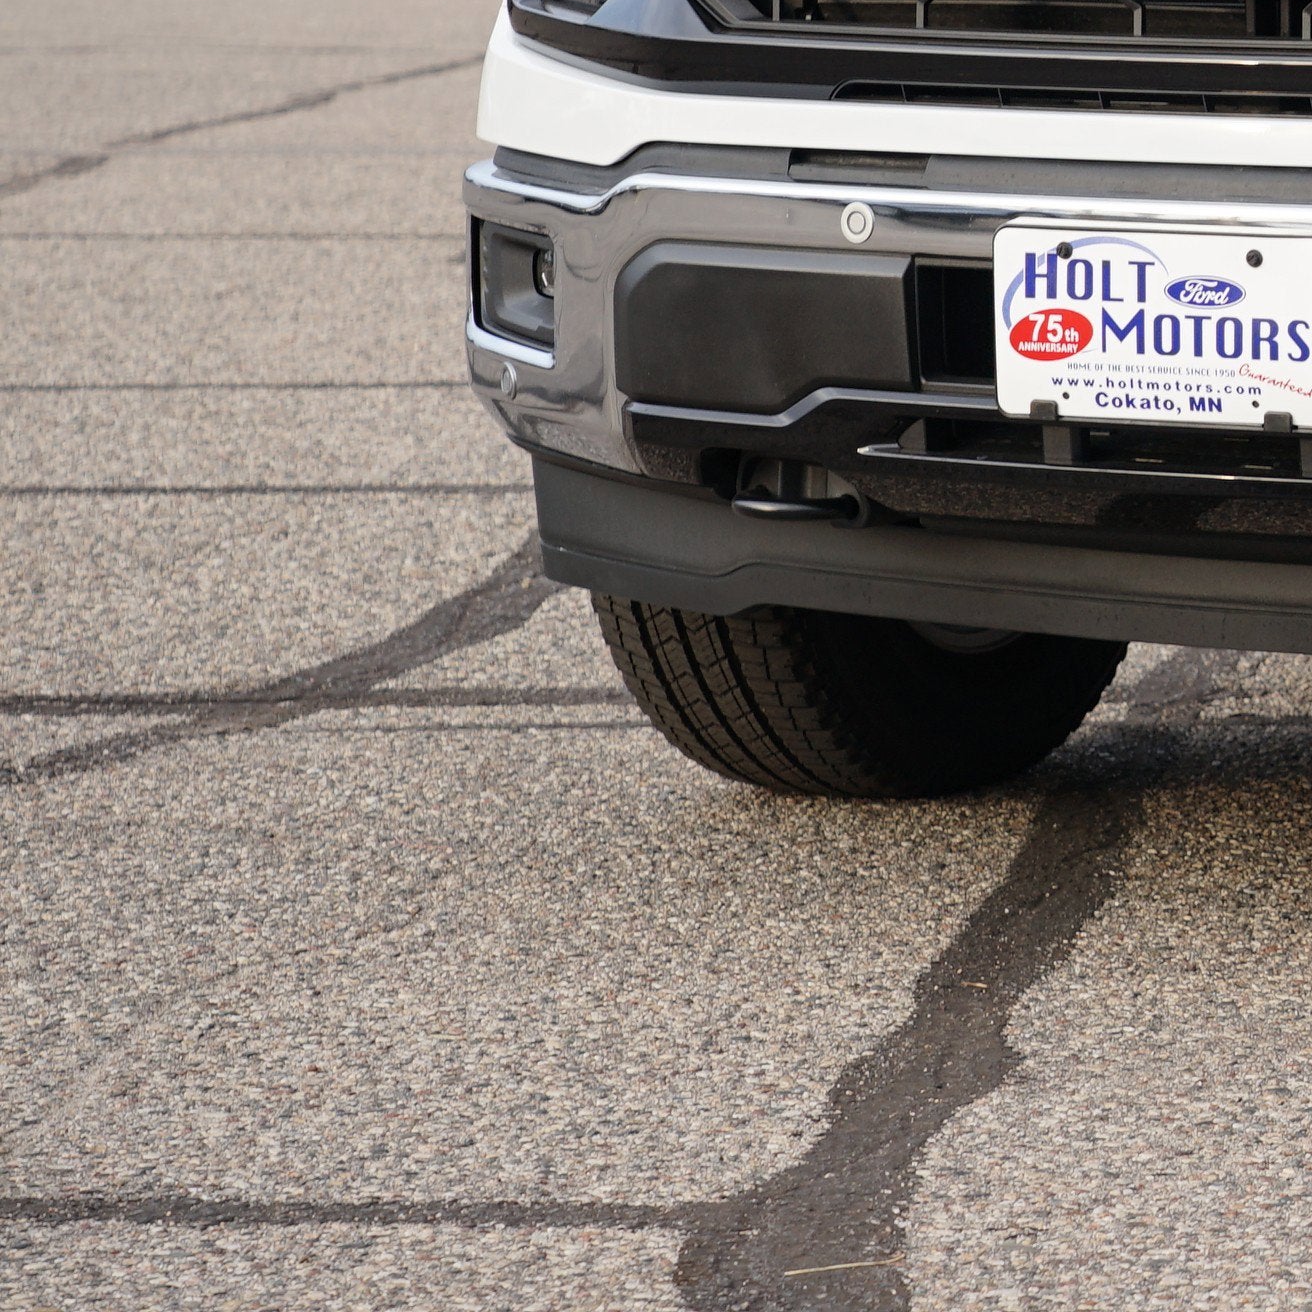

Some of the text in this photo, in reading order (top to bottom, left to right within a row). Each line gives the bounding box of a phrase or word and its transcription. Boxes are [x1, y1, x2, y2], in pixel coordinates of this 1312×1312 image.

[1024, 251, 1156, 303] HOLT
[1179, 279, 1231, 306] Ford
[1029, 313, 1080, 343] 75th
[1101, 306, 1310, 363] MOTORS
[1018, 341, 1079, 354] ANNIVERSARY
[1067, 362, 1236, 378] HOME OF THE BEST SERVICE SINCE 1950
[1051, 376, 1262, 396] www.holtmotors.com
[1095, 392, 1223, 415] Cokato, MN
